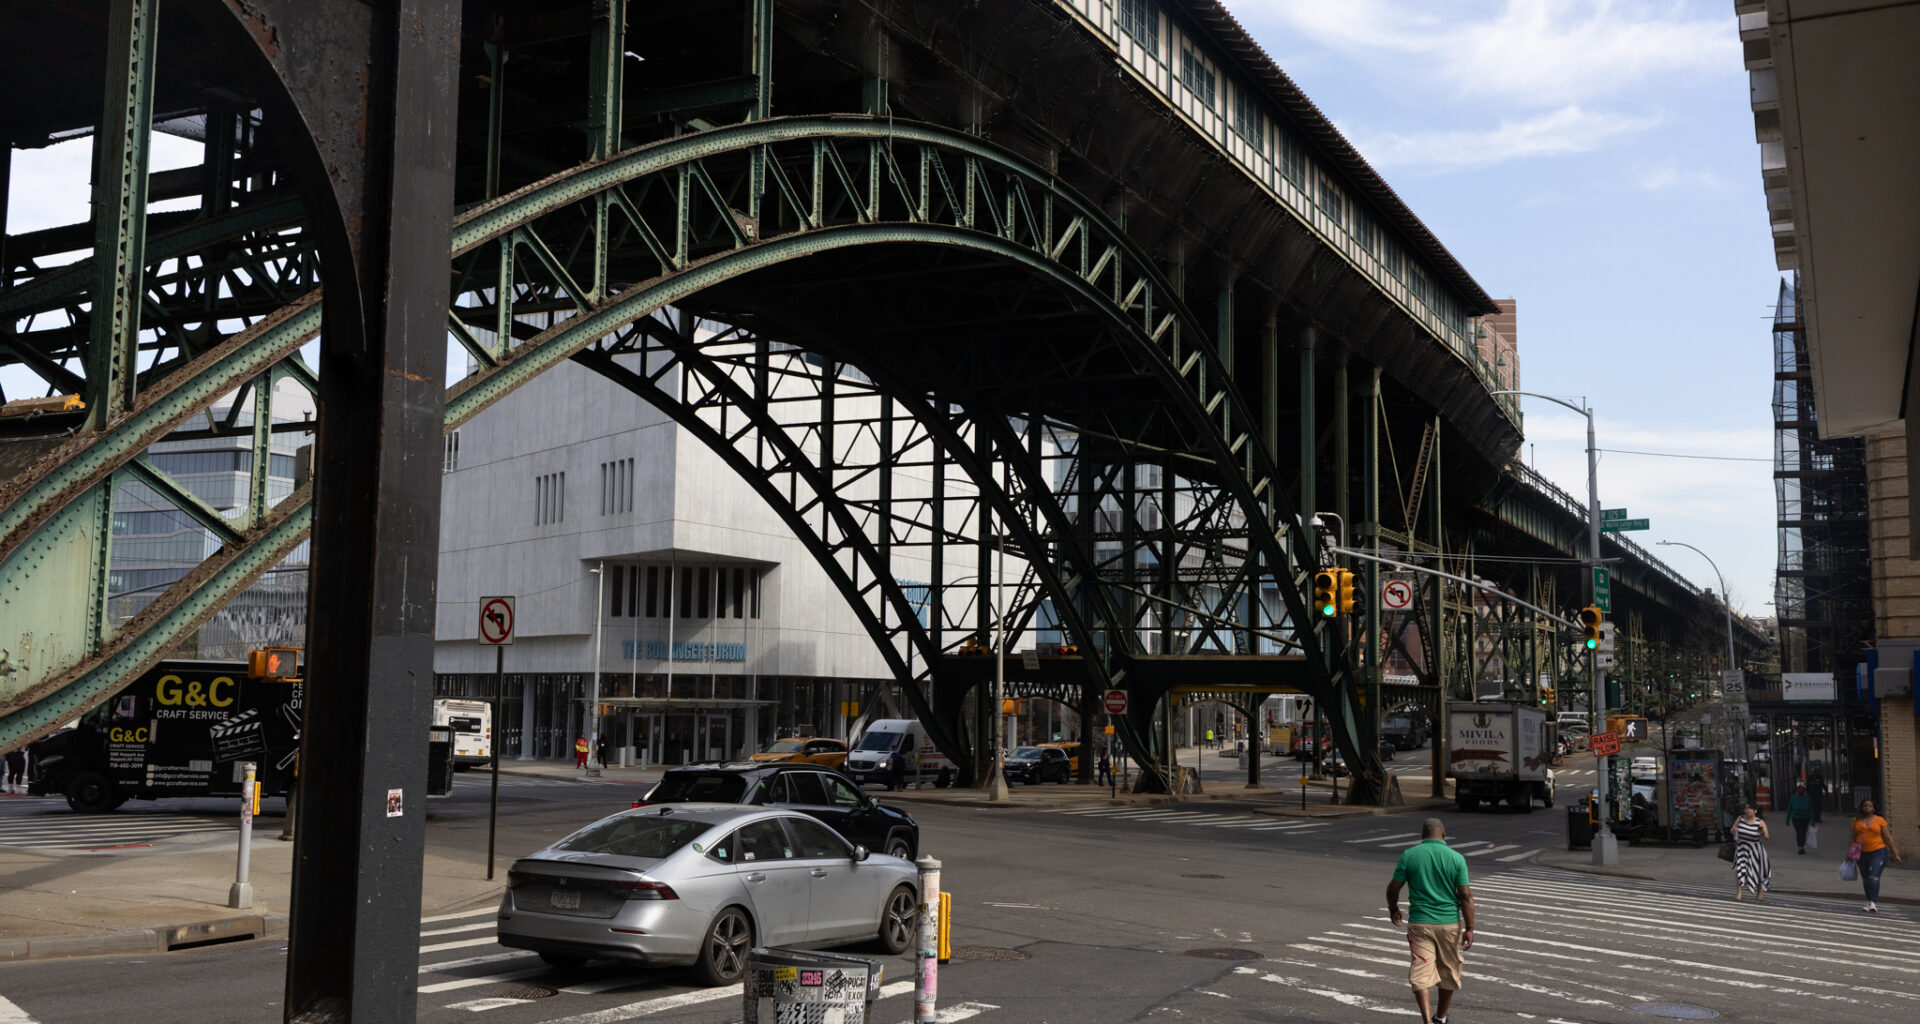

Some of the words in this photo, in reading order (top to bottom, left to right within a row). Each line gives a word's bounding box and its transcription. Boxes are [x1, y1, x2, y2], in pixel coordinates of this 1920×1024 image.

[709, 641, 746, 660] FORUM
[156, 675, 235, 707] G&C
[1726, 683, 1743, 692] 25
[156, 710, 187, 719] CRAFT
[189, 711, 229, 720] SERVICE
[110, 727, 148, 742] G&C
[1459, 730, 1505, 739] MIVILA
[1593, 733, 1616, 744] RAISE
